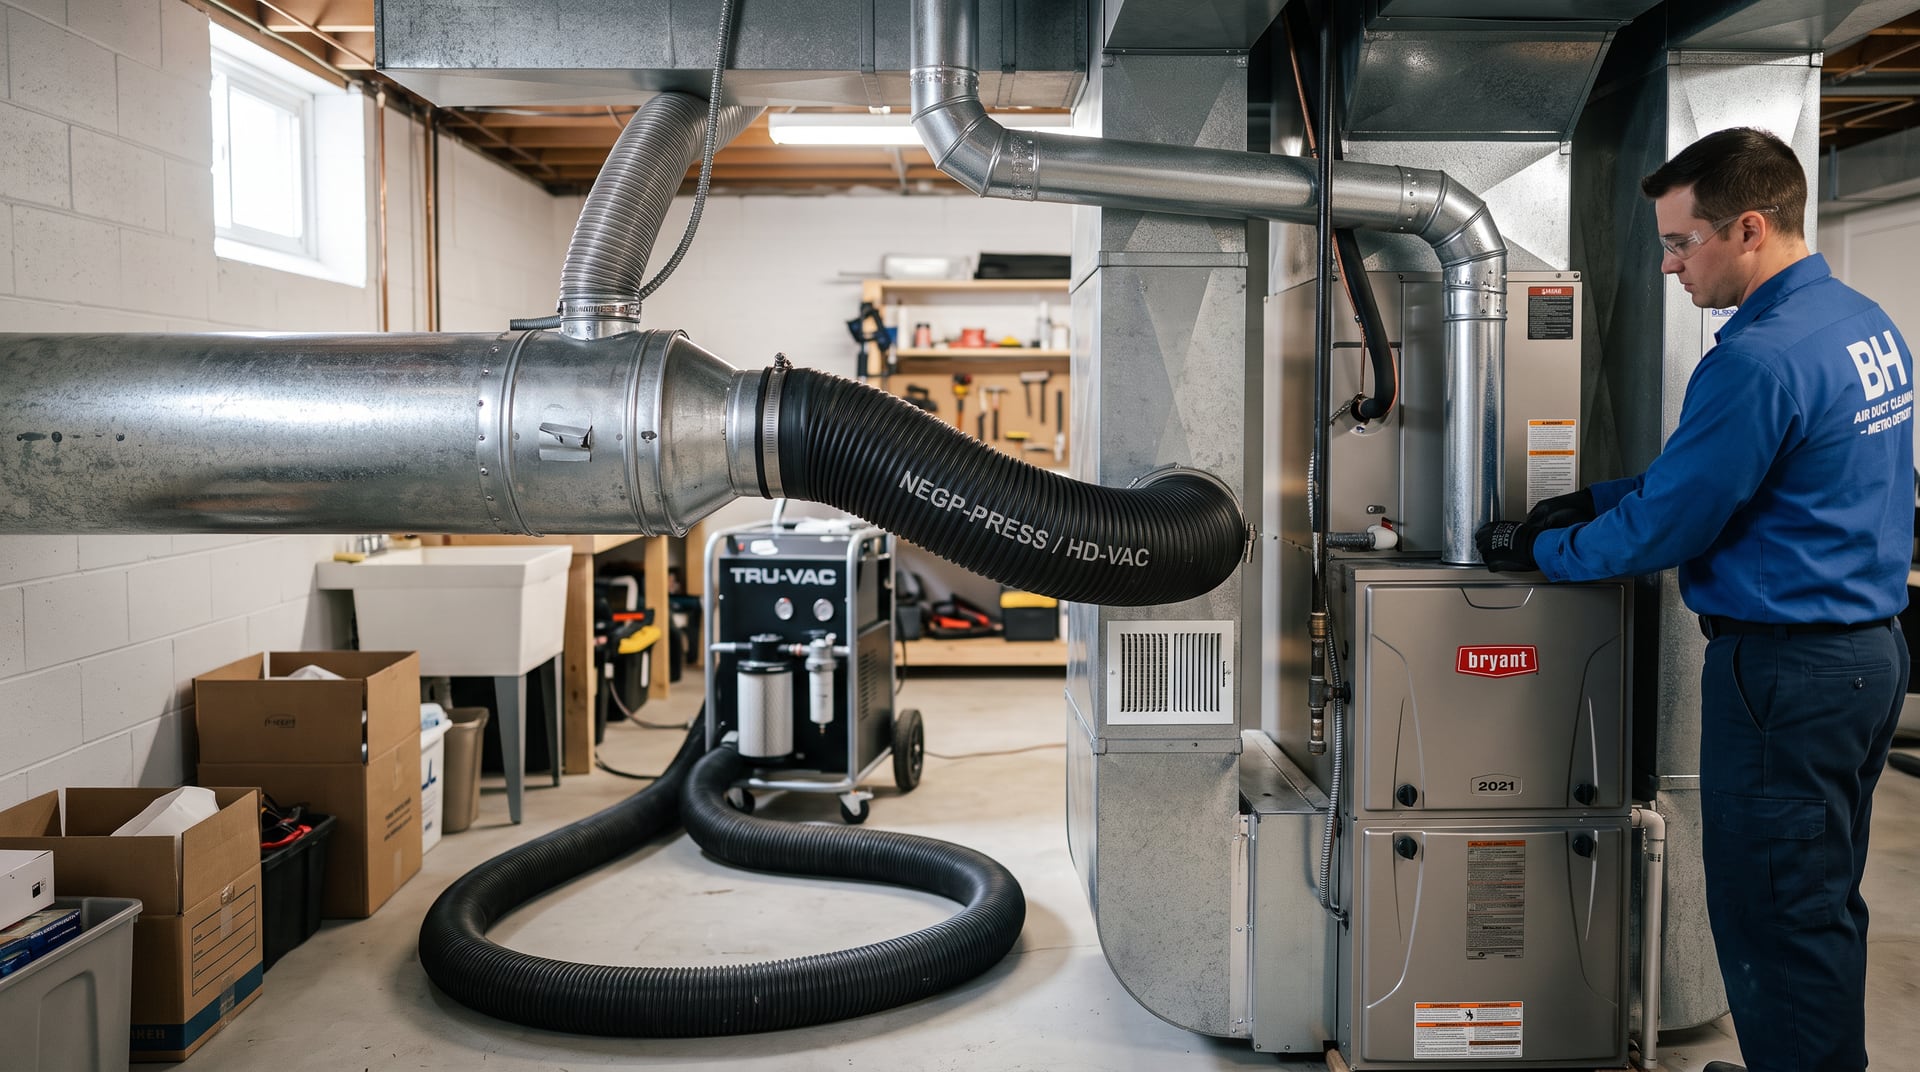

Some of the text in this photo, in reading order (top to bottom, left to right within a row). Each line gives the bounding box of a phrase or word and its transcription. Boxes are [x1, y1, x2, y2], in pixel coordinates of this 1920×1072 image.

[1846, 330, 1908, 401] BH
[1853, 408, 1871, 425] AIR
[1871, 400, 1889, 418] DUCT
[1868, 417, 1892, 435] METRO
[898, 470, 1049, 550] NEGP-PRESS
[1066, 538, 1150, 567] HD-VAC
[1468, 651, 1527, 671] bryant
[1478, 781, 1514, 791] 2021
